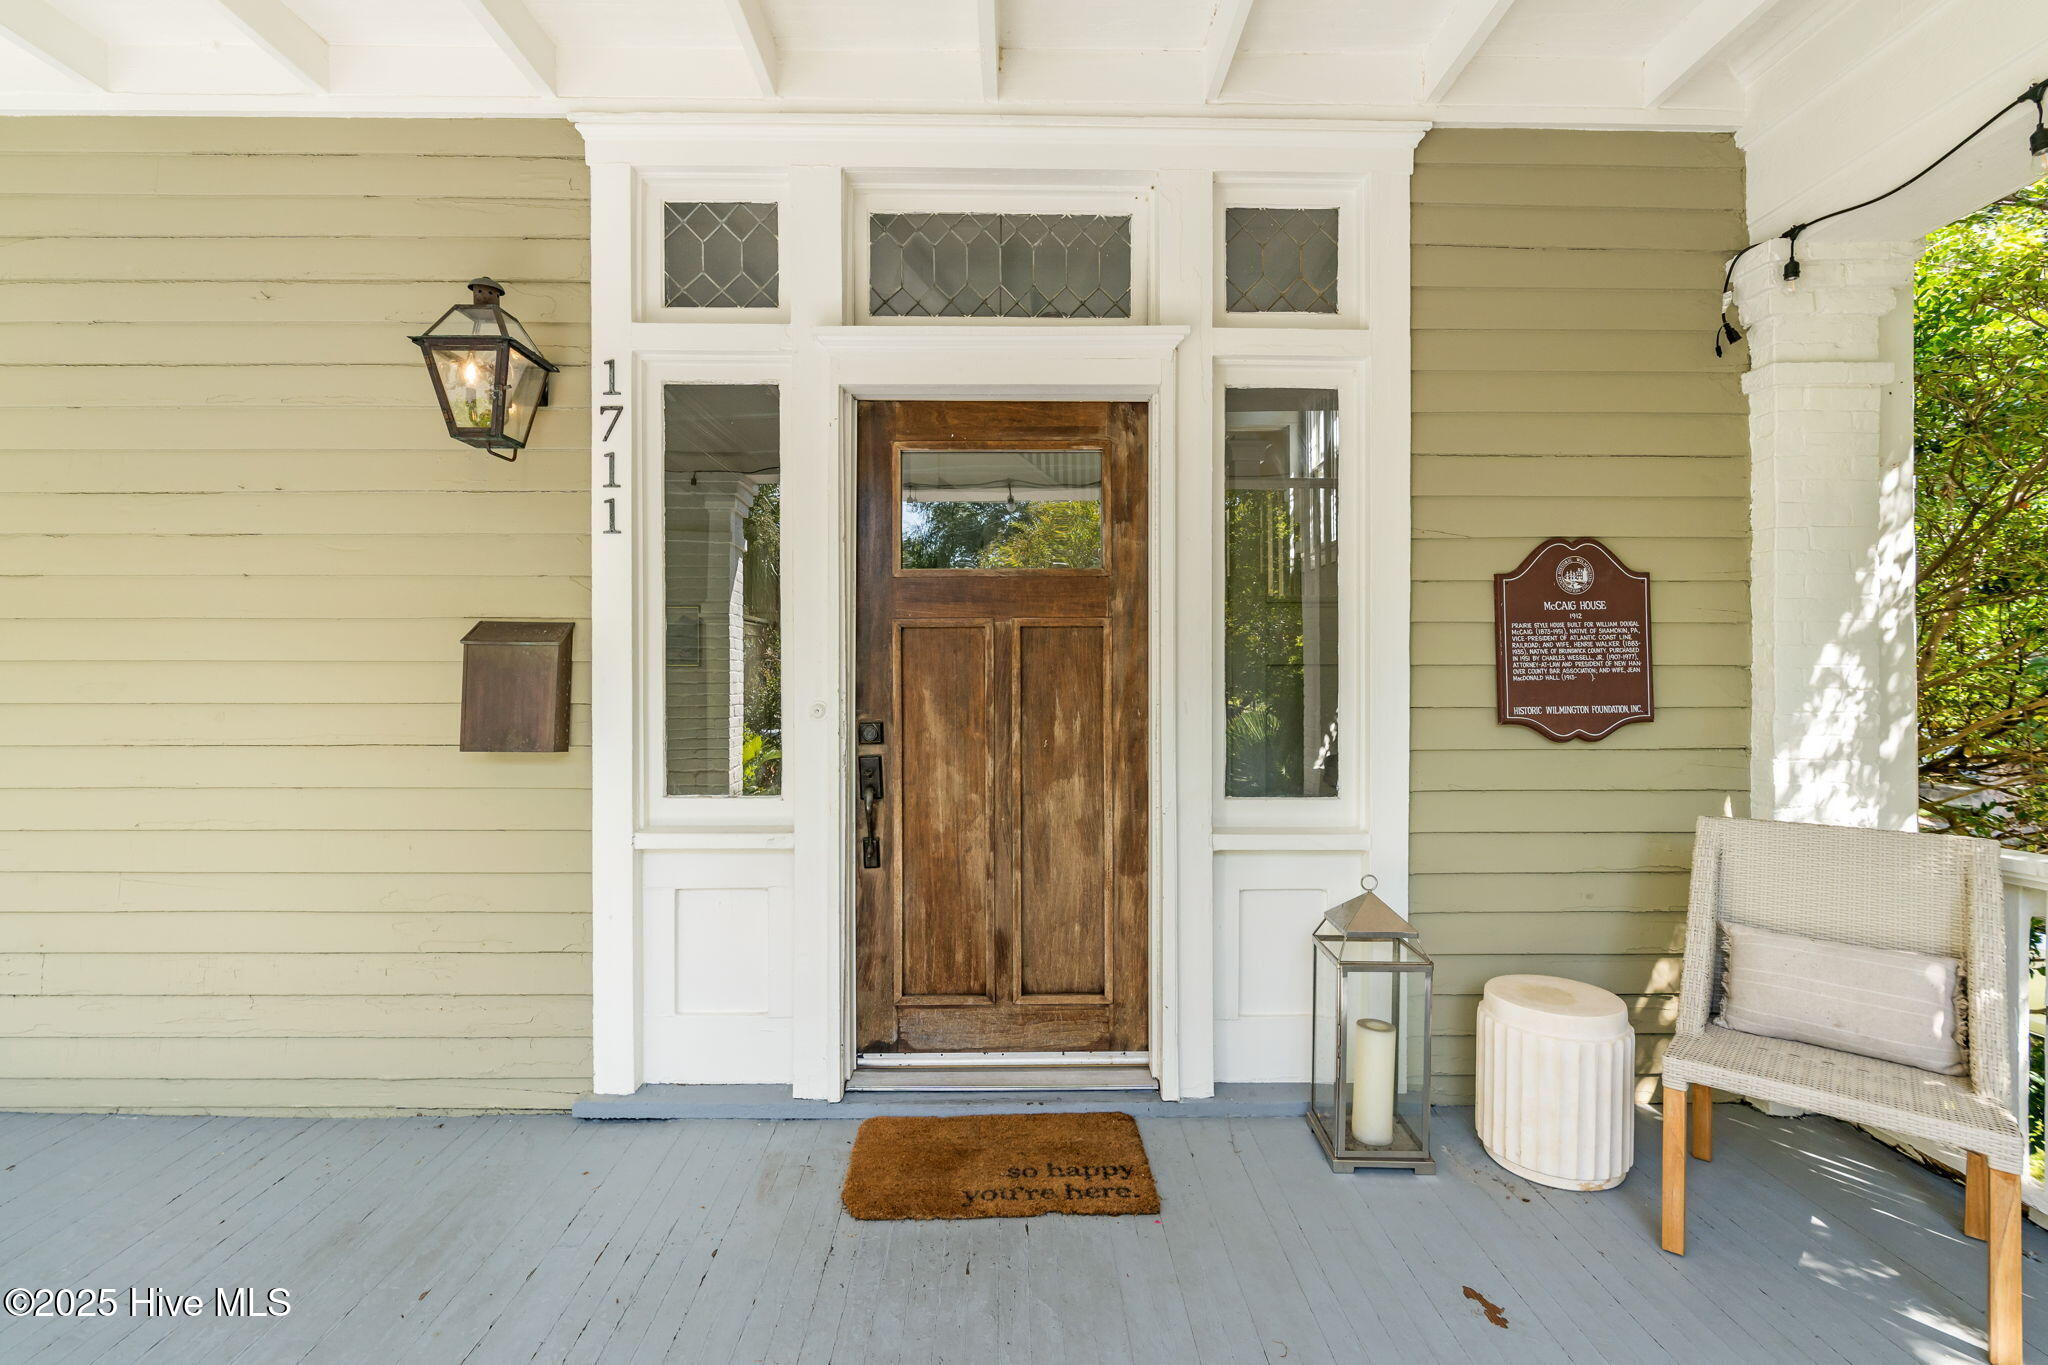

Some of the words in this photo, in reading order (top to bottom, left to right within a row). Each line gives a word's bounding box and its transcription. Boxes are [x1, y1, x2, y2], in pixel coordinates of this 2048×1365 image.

[600, 359, 623, 534] 1711
[1544, 601, 1576, 610] McCAIG
[1580, 600, 1606, 610] HOUSE
[1514, 706, 1542, 715] HISTORIC
[1546, 706, 1589, 714] WILMINGTON
[1006, 1165, 1038, 1179] so
[1047, 1162, 1134, 1180] happy
[961, 1186, 1056, 1208] you're
[1064, 1183, 1140, 1200] here.
